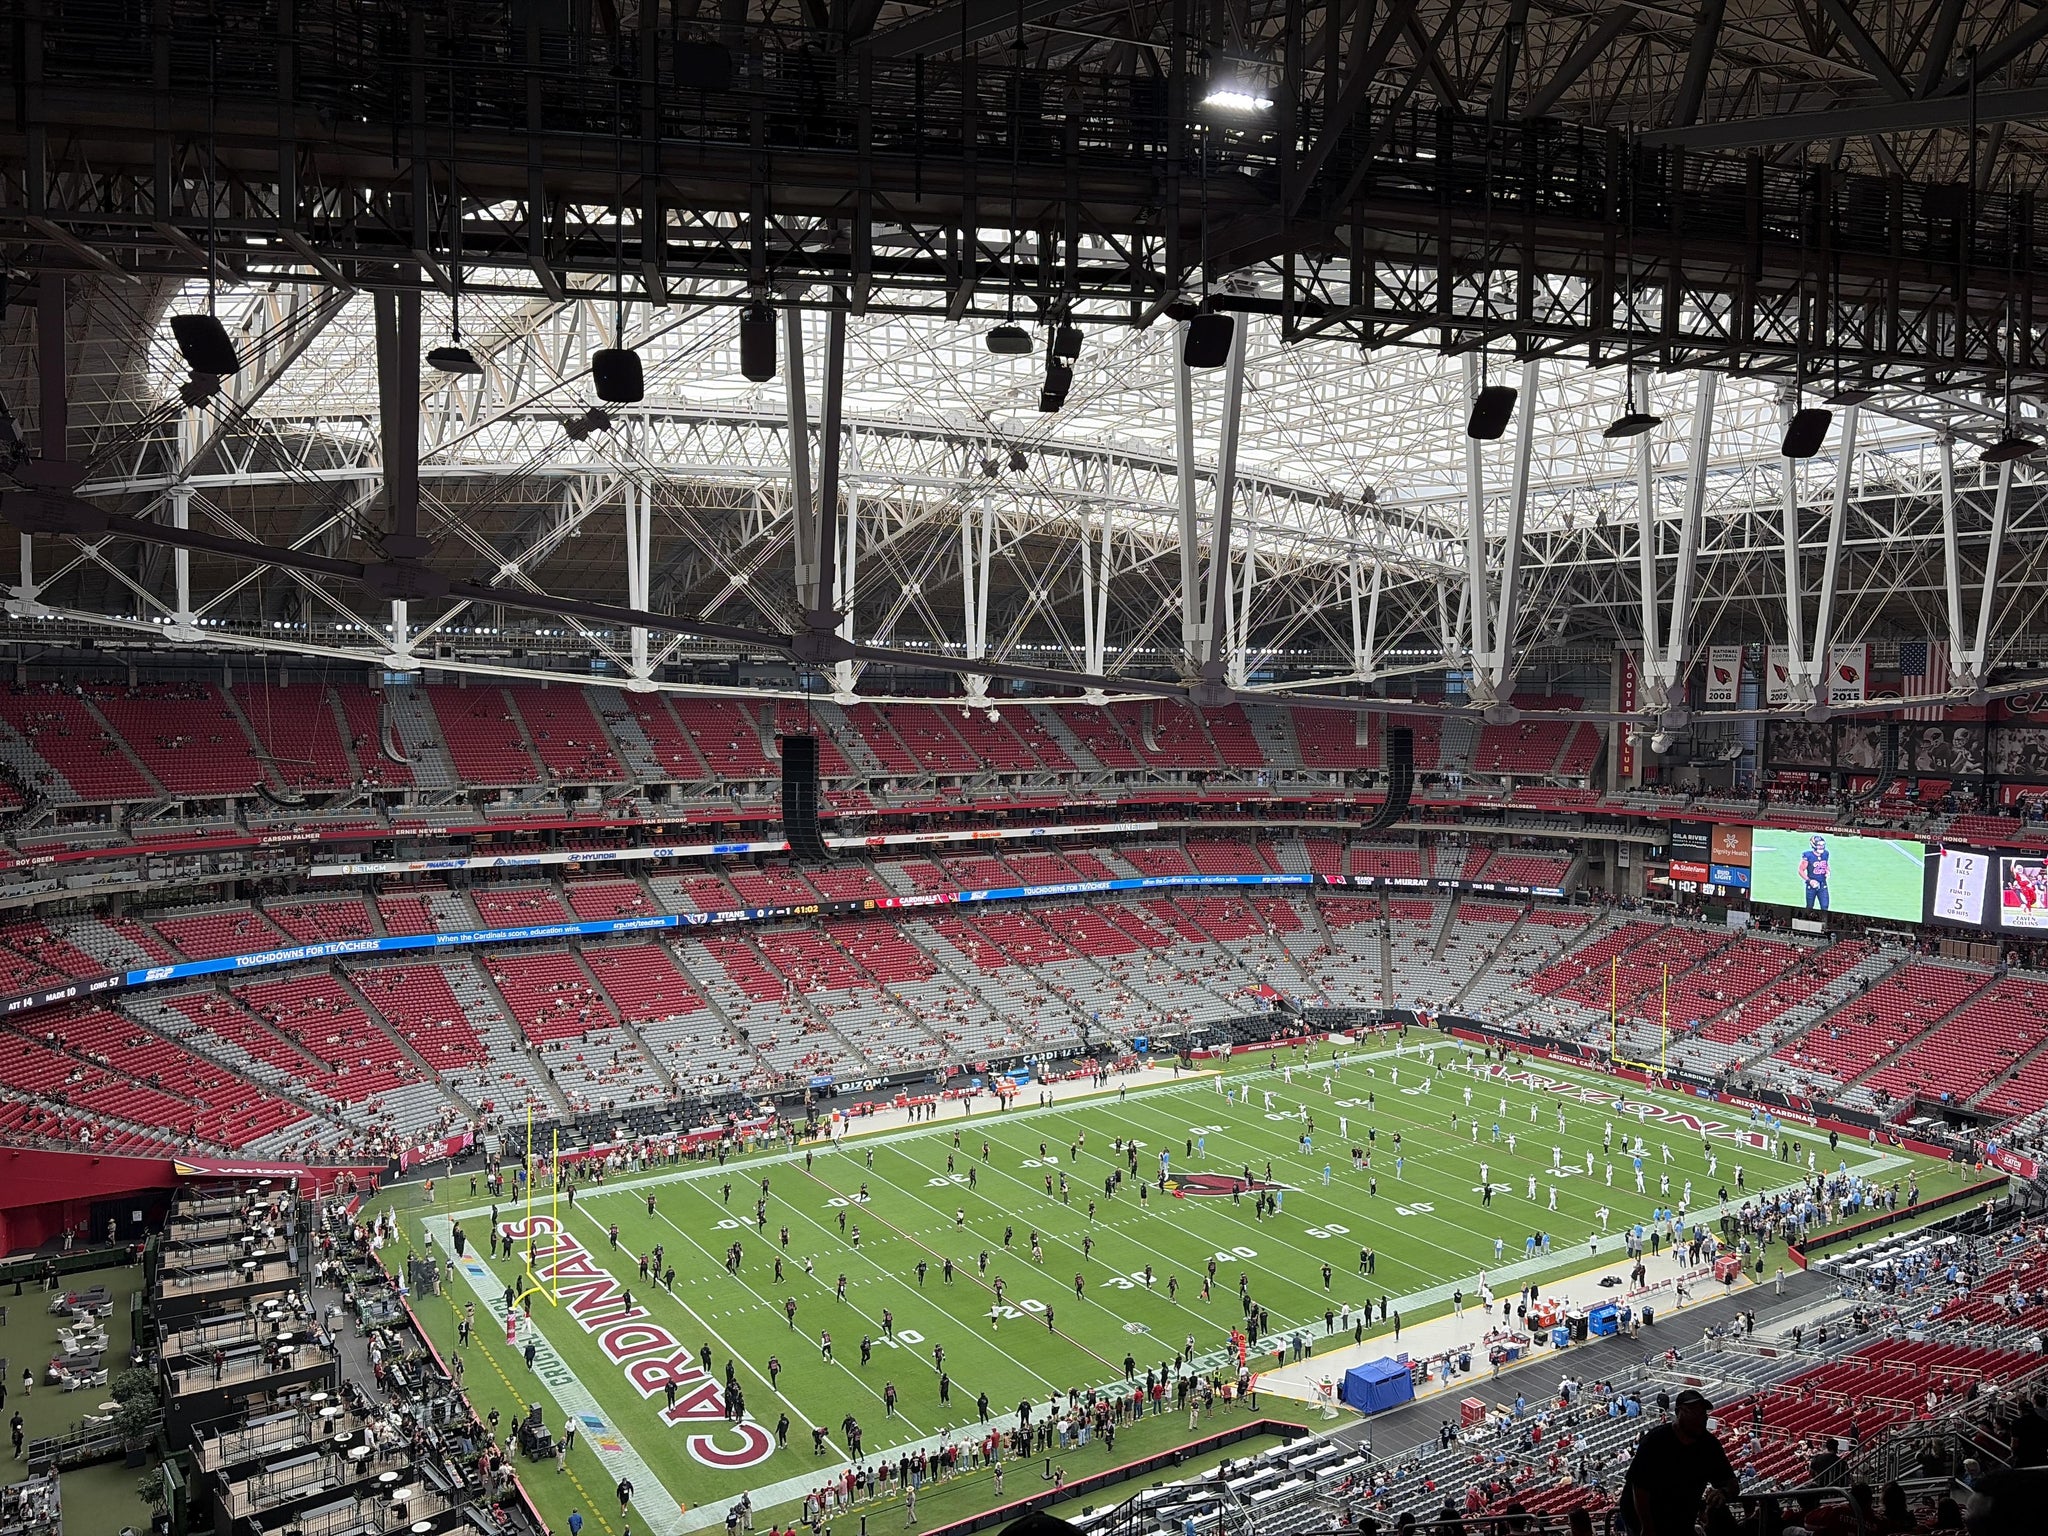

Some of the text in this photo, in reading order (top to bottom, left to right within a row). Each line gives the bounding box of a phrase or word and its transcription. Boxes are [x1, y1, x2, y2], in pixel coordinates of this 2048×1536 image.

[1709, 692, 1732, 700] 2008
[1770, 692, 1788, 701] 2009
[1832, 692, 1860, 701] 2015
[1825, 826, 1861, 834] CARDINALS
[262, 835, 292, 843] CARSON
[293, 833, 321, 841] PALMER
[1688, 834, 1708, 842] RIVER
[1943, 835, 1968, 843] HONOR
[582, 852, 617, 860] HYUNDAI
[653, 848, 674, 857] COX
[1712, 849, 1750, 858] Dignity Health
[15, 859, 30, 867] ROY
[31, 856, 55, 865] GREEN
[425, 861, 454, 869] FINANCIAL
[1955, 857, 1973, 871] 12
[1394, 878, 1428, 886] MURRAY
[1958, 879, 1964, 890] 1
[1024, 885, 1066, 894] TOUCHDOWNS
[886, 894, 938, 906] 0 CARDINALS
[1954, 898, 1964, 910] 5
[716, 910, 745, 920] TITANS
[757, 909, 765, 918] 0
[793, 904, 819, 914] 41:02
[613, 919, 666, 929] srp.net/teachers
[436, 935, 459, 943] When
[473, 931, 507, 940] Cardinals
[507, 930, 528, 938] score,
[530, 927, 563, 936] education
[235, 941, 381, 967] TOUCHDOWNS FOR TEACHERS
[89, 976, 119, 991] LONG 57
[45, 987, 77, 1002] MADE 10
[8, 997, 33, 1011] ATT 14
[1481, 1023, 1503, 1033] ARIZONA
[1547, 1052, 1577, 1064] ARIZONA
[1730, 1097, 1768, 1113] ARIZONA
[217, 1166, 304, 1176] verizon
[1394, 1202, 1434, 1216] 40
[1304, 1223, 1350, 1239] 50
[1214, 1246, 1258, 1263] 40
[1108, 1271, 1158, 1290] 30
[999, 1299, 1047, 1320] 20
[497, 1215, 777, 1471] CARDINALS
[884, 1329, 926, 1350] 10
